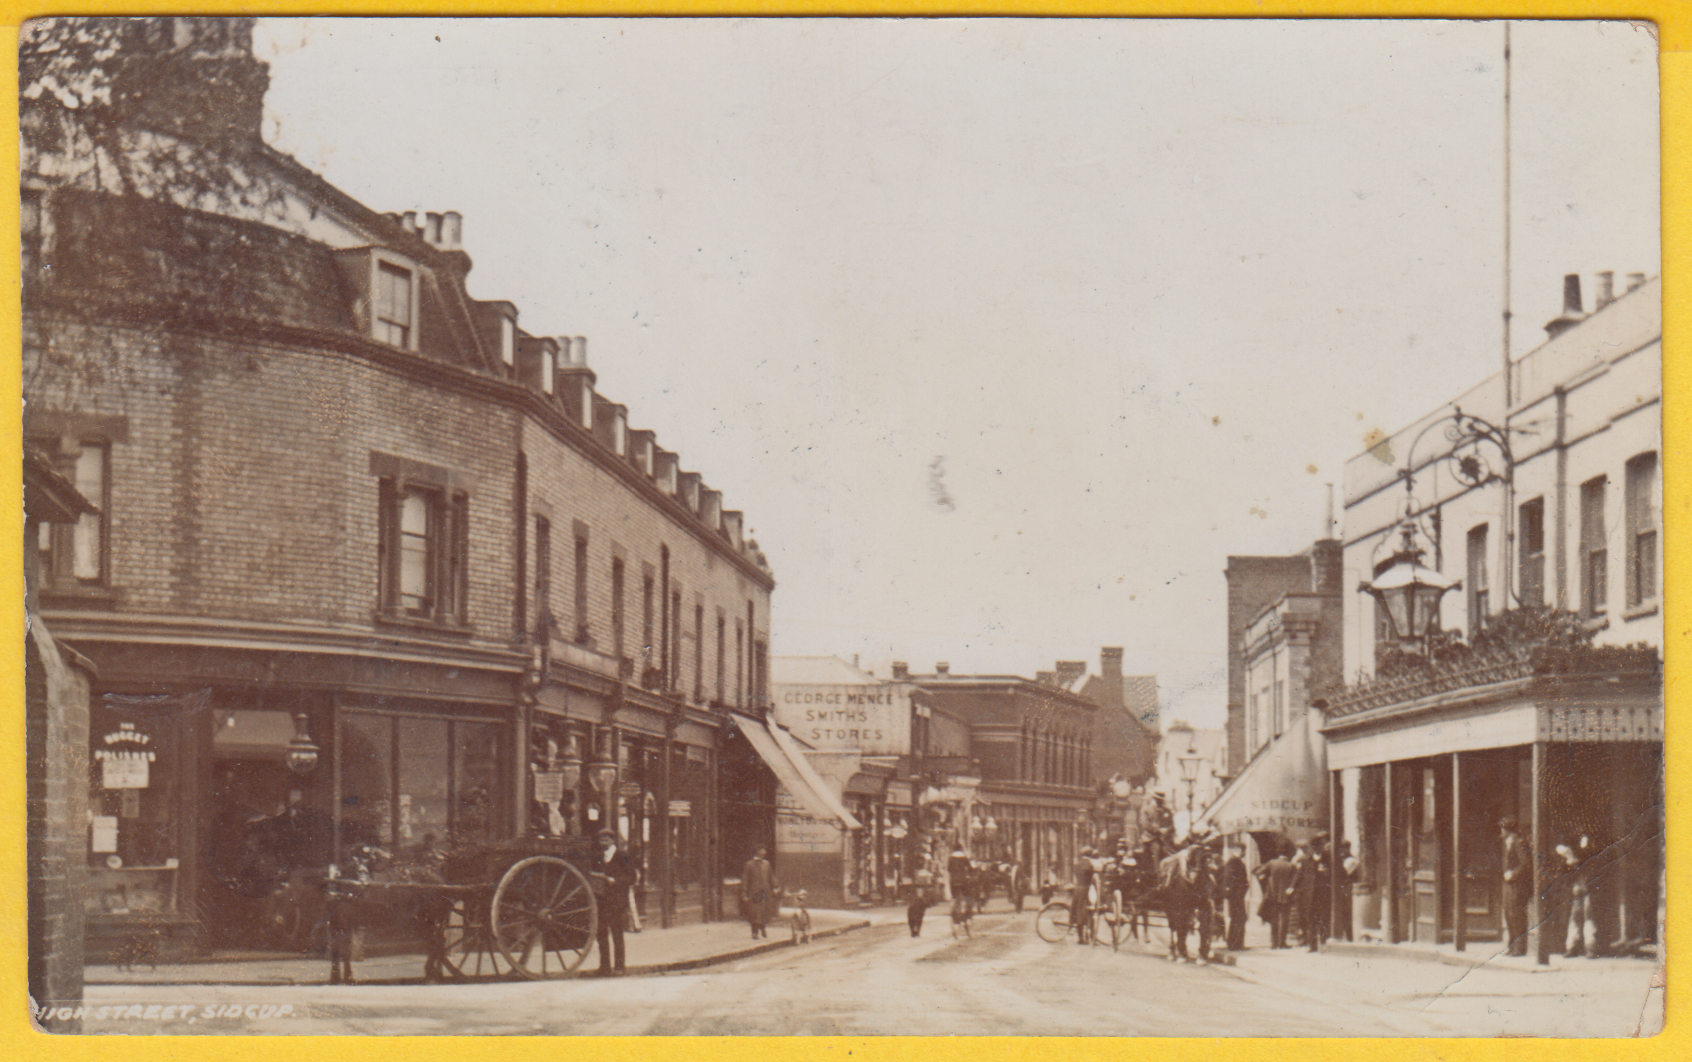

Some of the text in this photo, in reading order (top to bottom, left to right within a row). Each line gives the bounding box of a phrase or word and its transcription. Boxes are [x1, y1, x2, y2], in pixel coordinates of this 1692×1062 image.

[784, 692, 893, 705] GEORGE MENCE
[806, 709, 867, 722] SMITHS
[811, 728, 883, 740] STORES
[1251, 800, 1313, 811] SIDCUP
